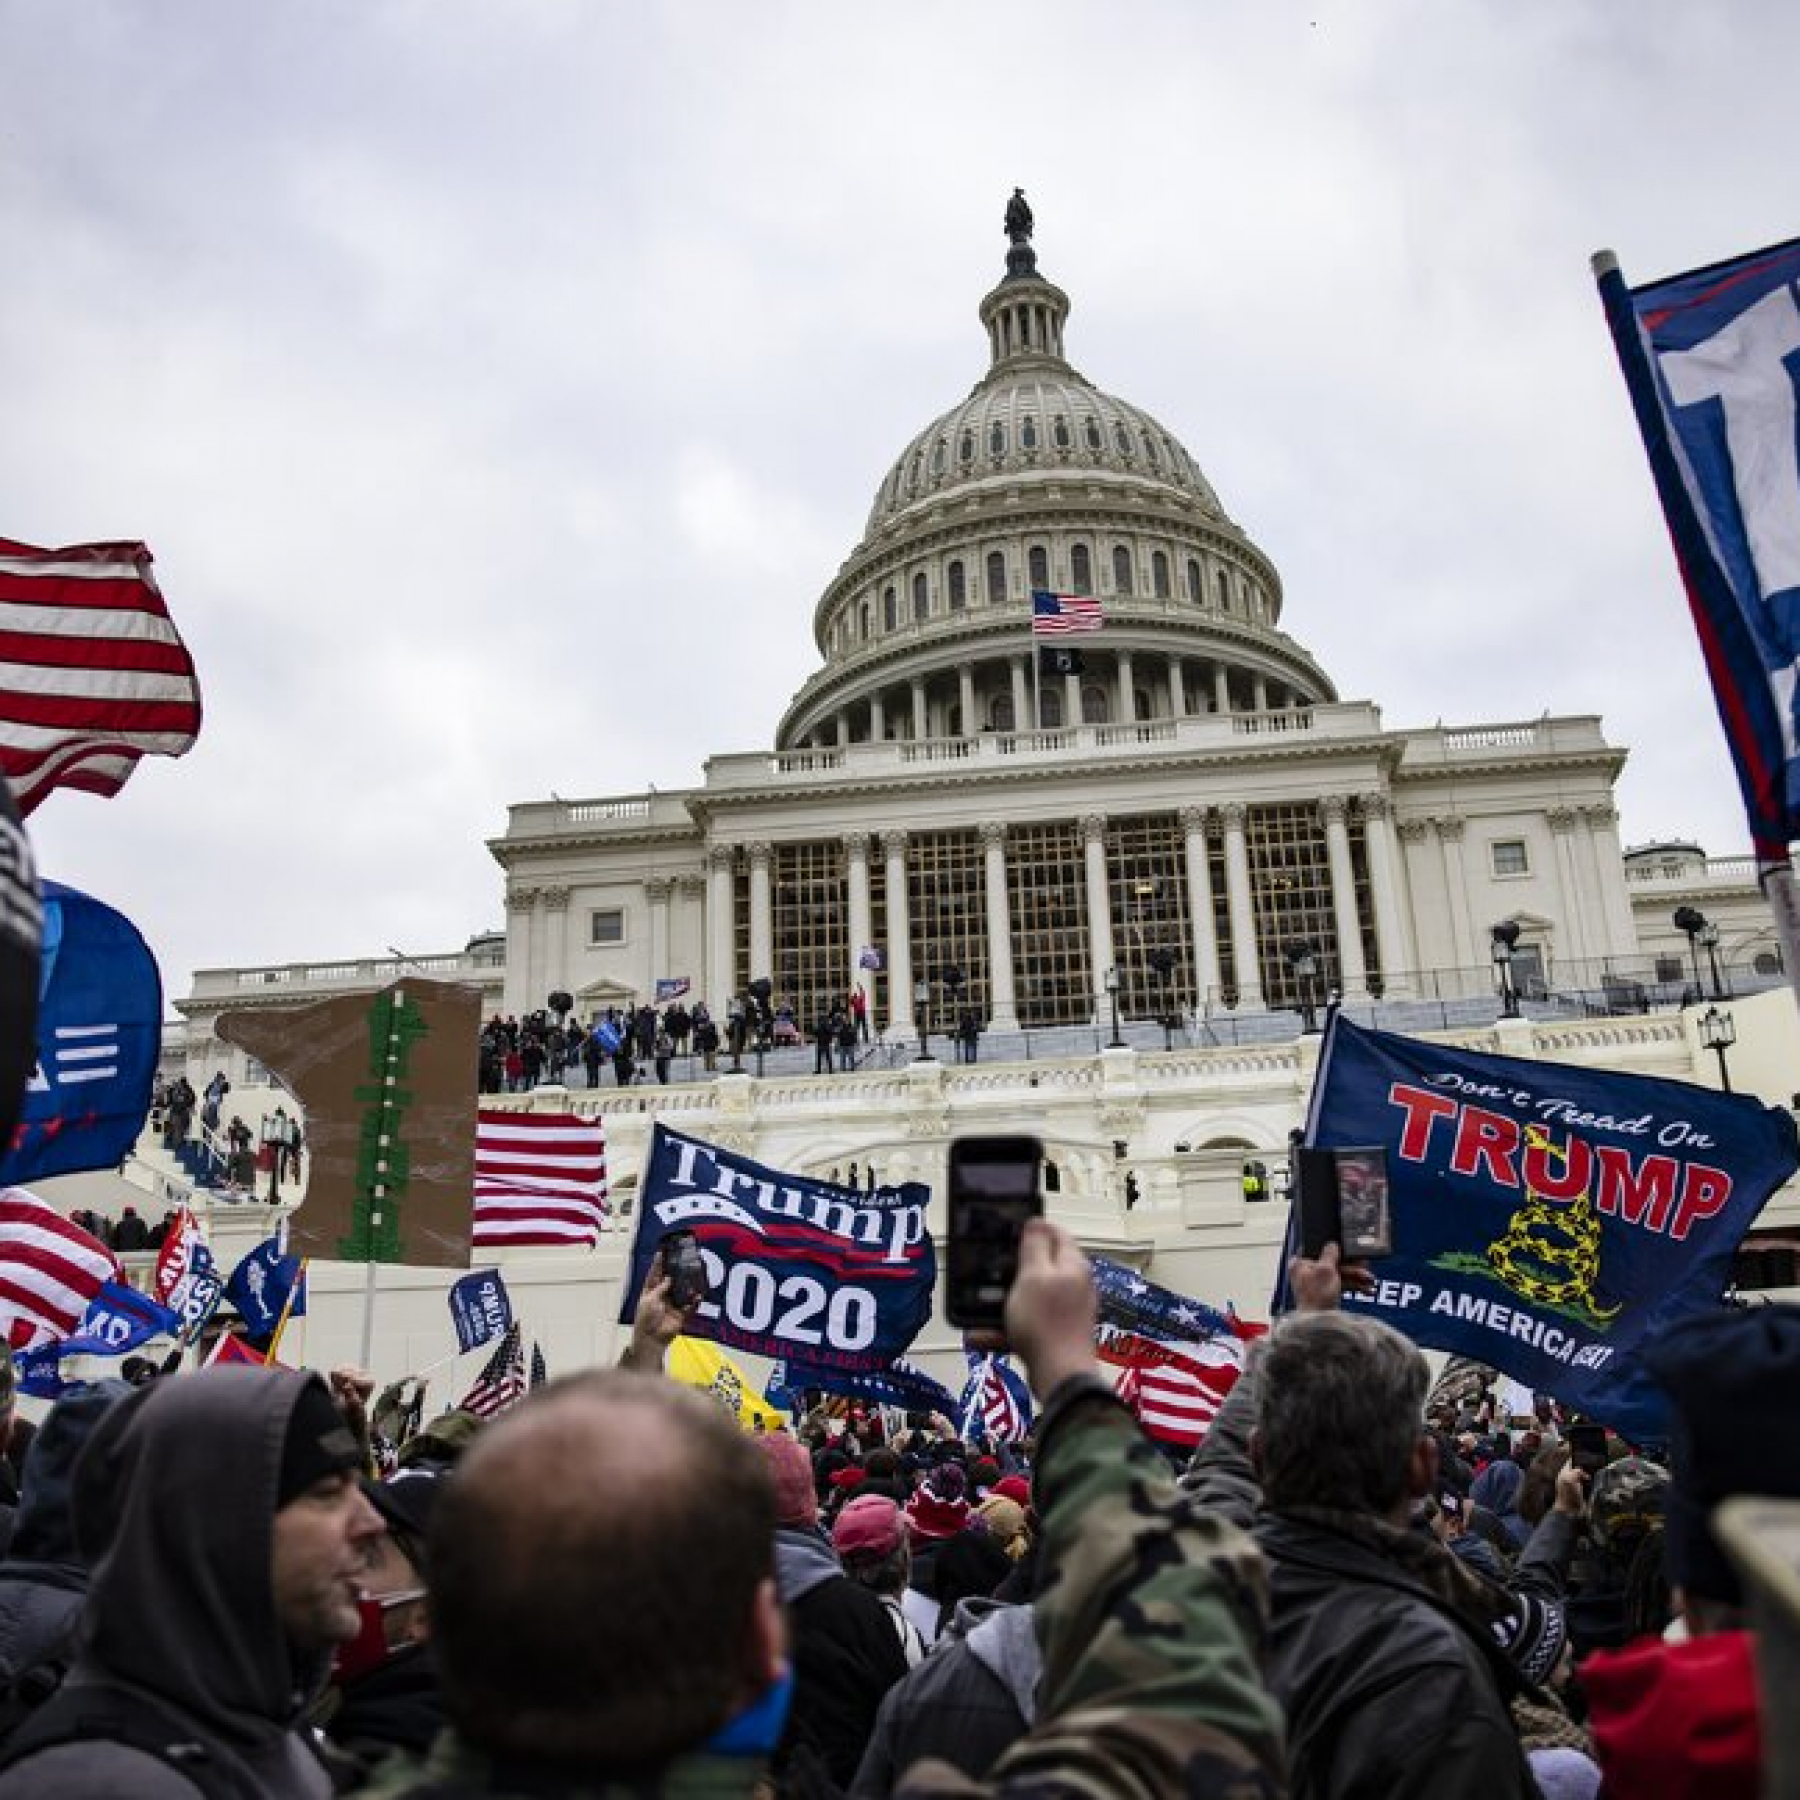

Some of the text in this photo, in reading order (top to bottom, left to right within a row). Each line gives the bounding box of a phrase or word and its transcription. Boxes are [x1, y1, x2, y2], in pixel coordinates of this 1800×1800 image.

[1389, 1082, 1733, 1241] TRUMP
[1422, 1073, 1715, 1147] Don't Tread On
[664, 1135, 928, 1263] Trump
[1343, 1279, 1422, 1308] EP
[1429, 1289, 1576, 1363] AMERICA
